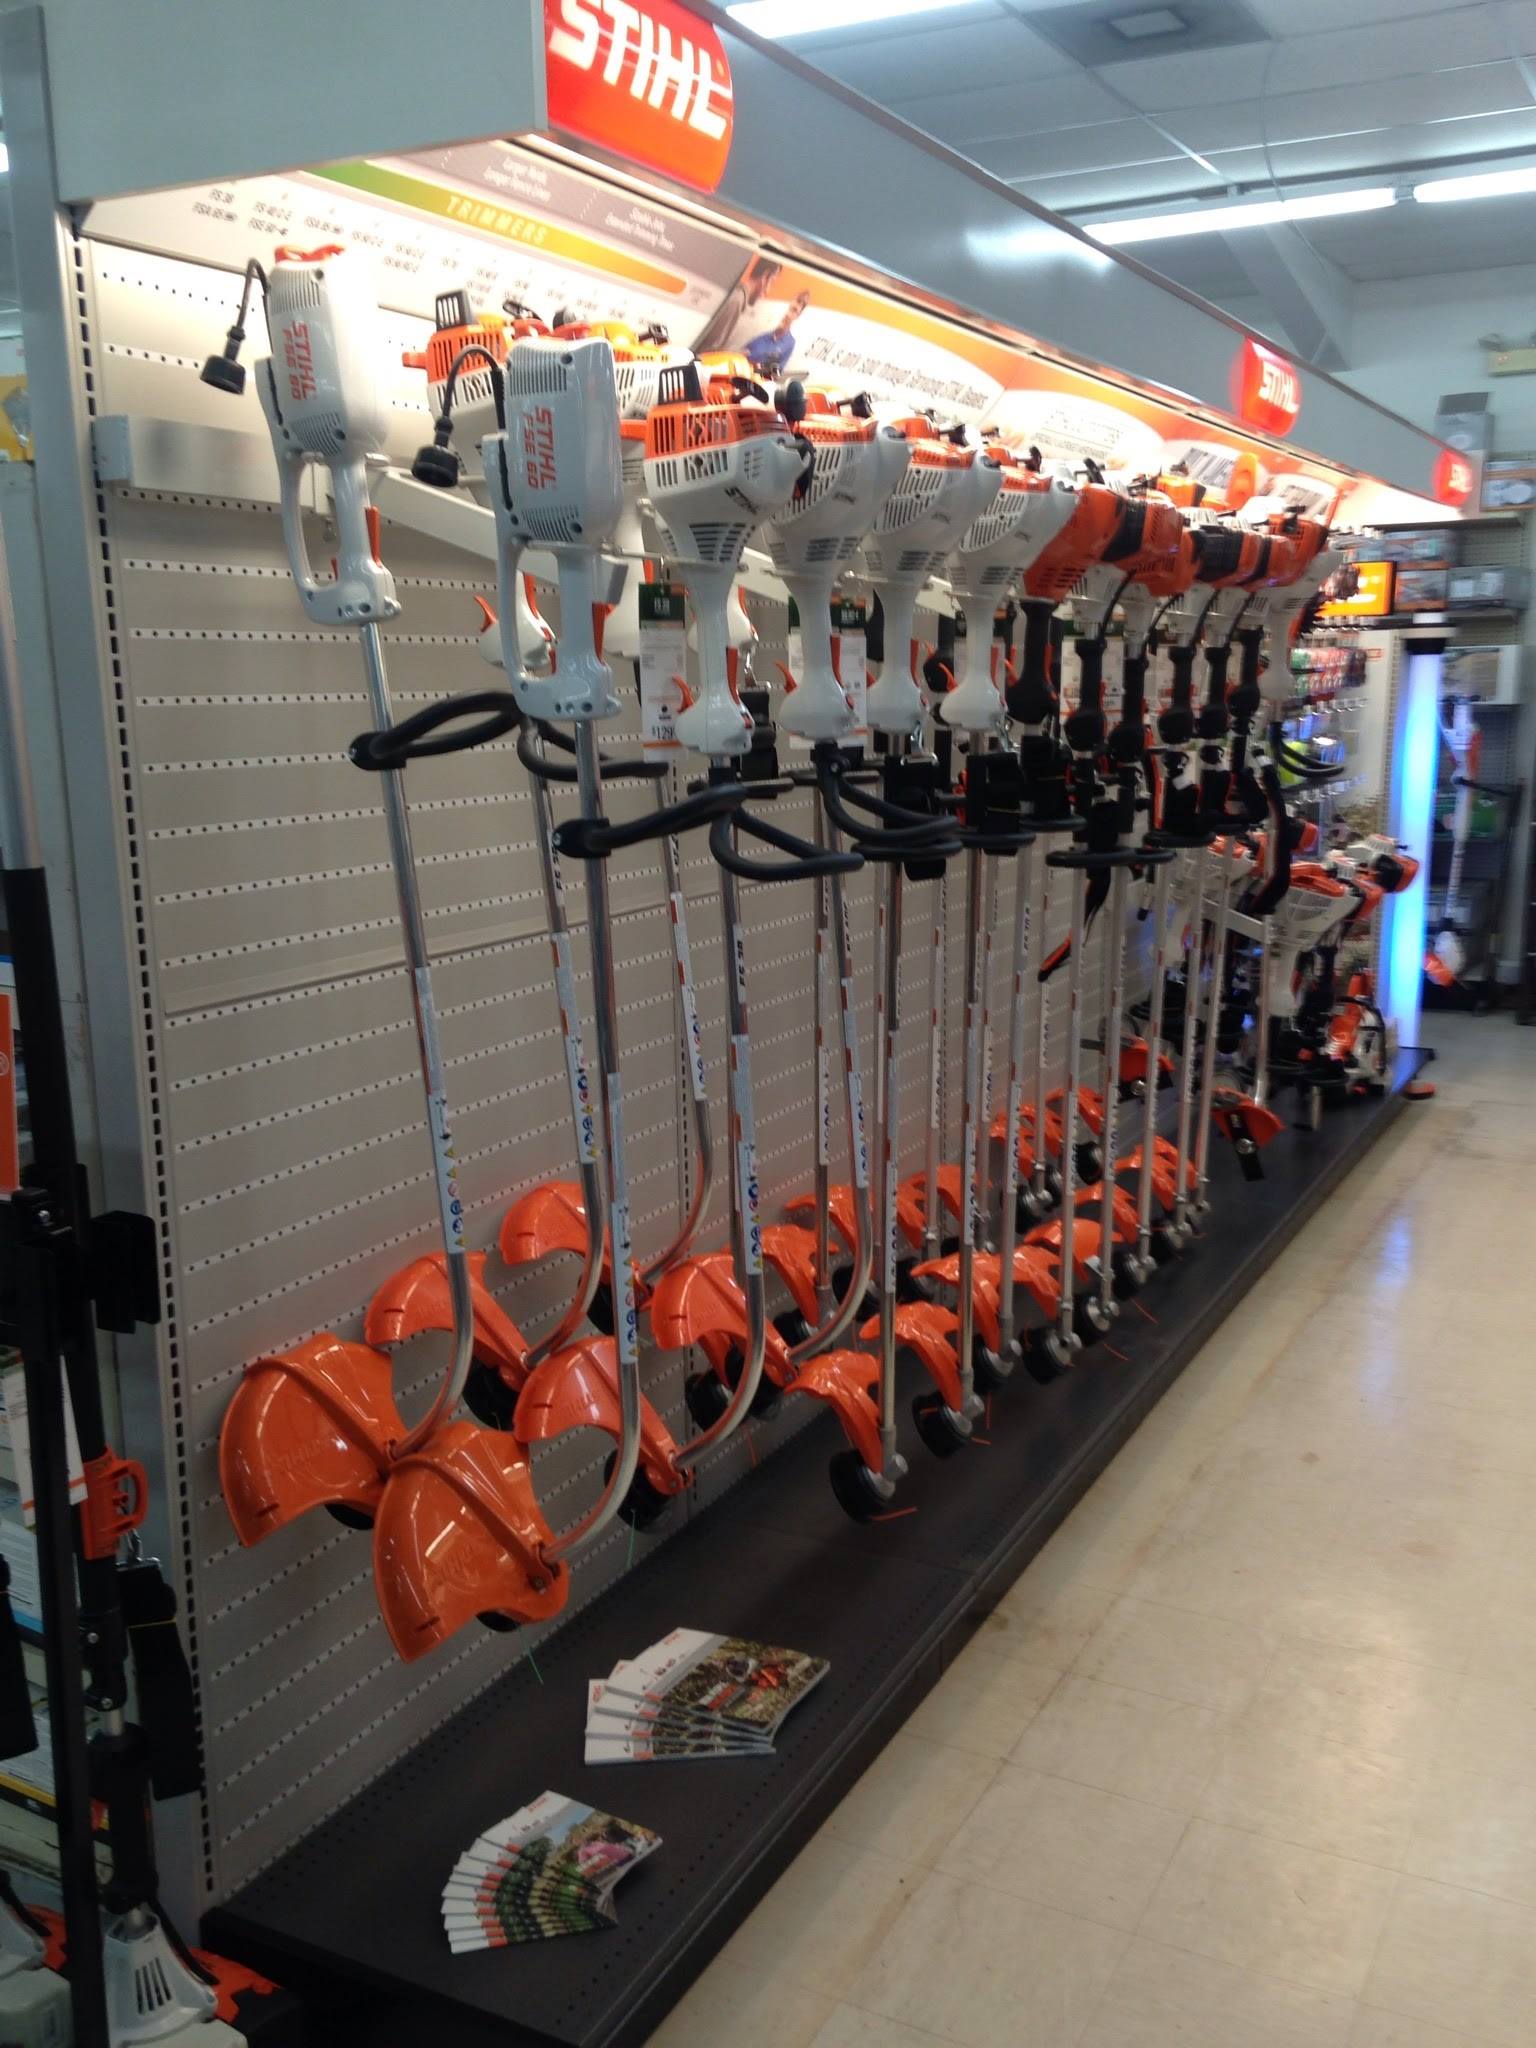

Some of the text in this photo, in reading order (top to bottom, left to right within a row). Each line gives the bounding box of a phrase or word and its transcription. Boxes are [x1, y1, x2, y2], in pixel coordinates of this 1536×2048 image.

[549, 0, 729, 140] STIHL
[446, 195, 548, 245] TRIMMERS
[291, 320, 317, 400] STIHL
[522, 411, 539, 489] FSE 60
[535, 406, 556, 490] STIHL
